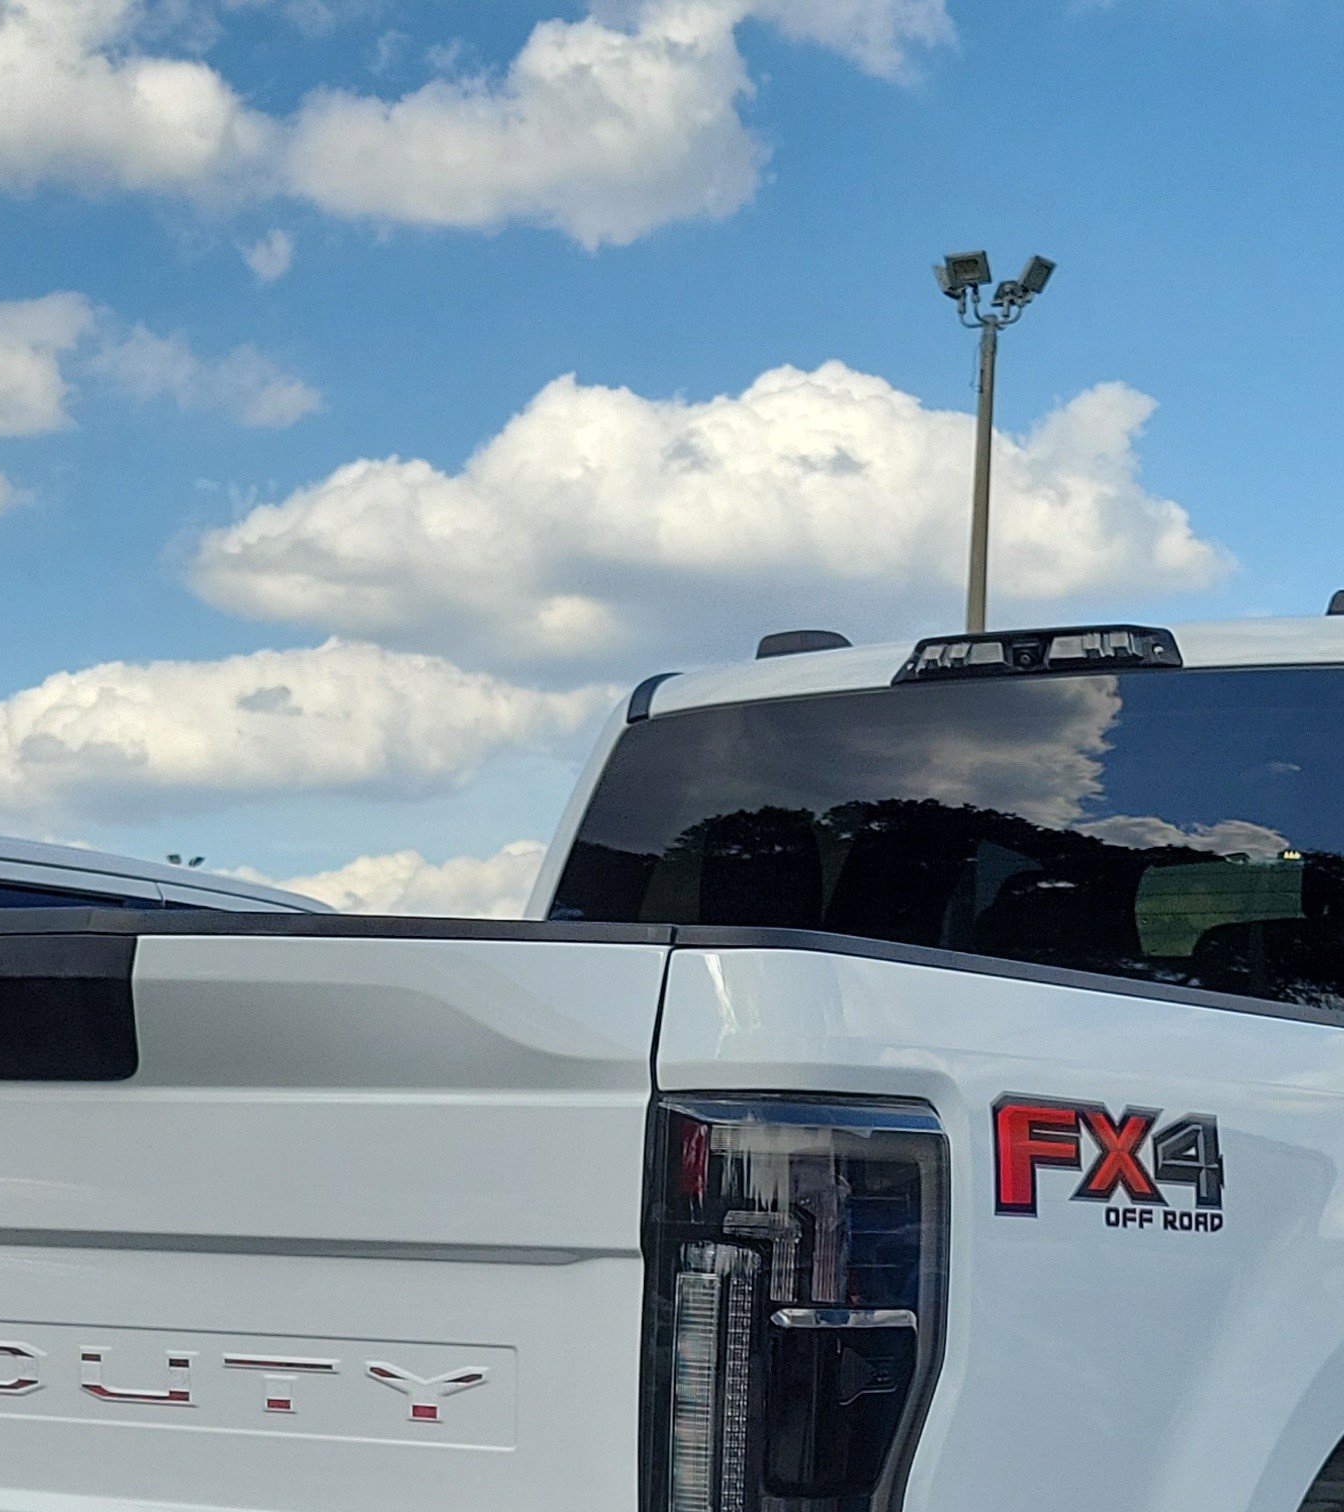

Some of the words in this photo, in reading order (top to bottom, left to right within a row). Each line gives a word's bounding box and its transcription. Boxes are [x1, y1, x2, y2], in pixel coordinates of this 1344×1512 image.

[990, 1091, 1224, 1218] FX4
[1105, 1206, 1153, 1229] OFF
[1162, 1209, 1224, 1233] ROAD
